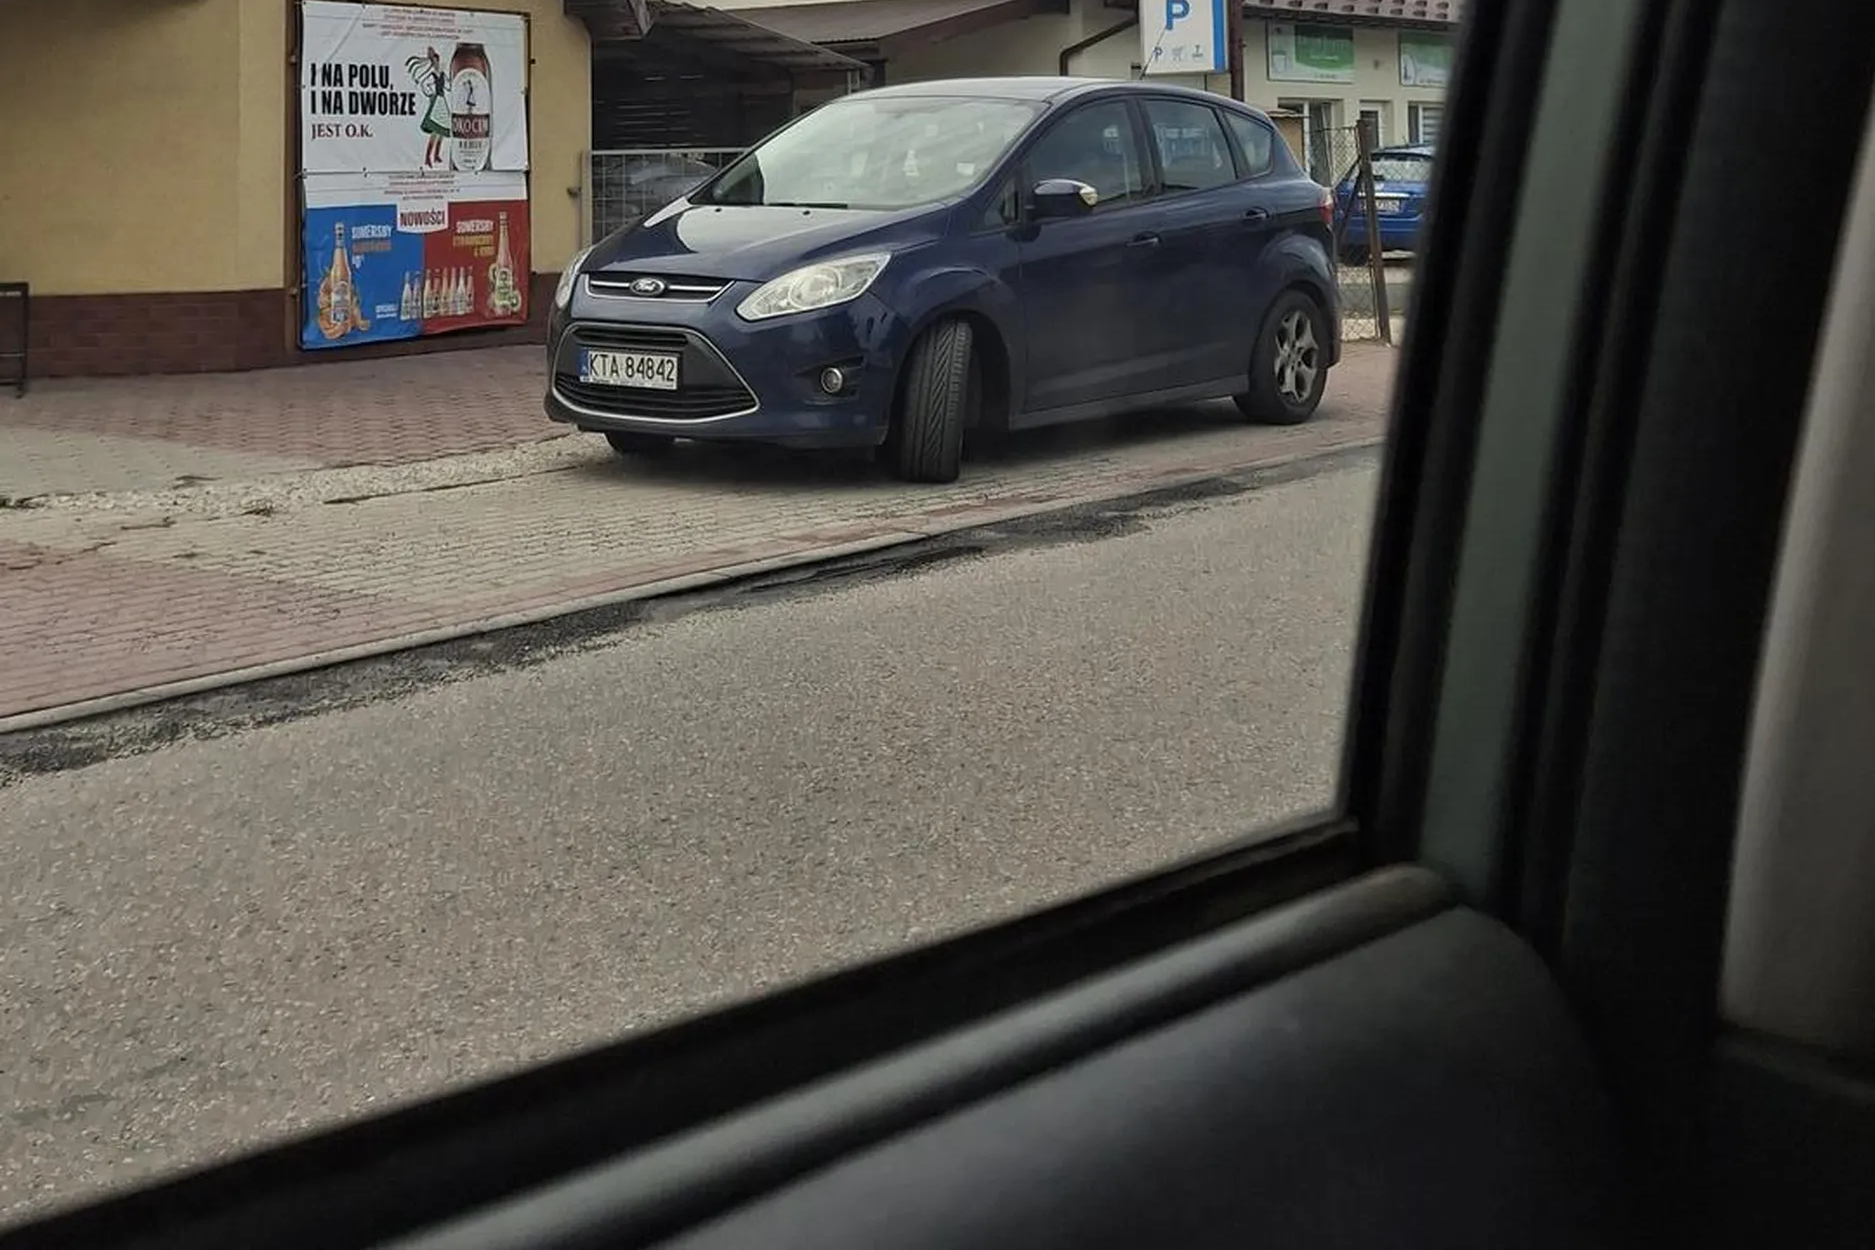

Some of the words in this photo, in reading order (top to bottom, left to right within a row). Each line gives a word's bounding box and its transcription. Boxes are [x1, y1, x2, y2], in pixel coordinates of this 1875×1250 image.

[310, 63, 317, 87] I
[321, 63, 343, 87] NA
[348, 64, 394, 90] POLU,
[310, 90, 317, 115] I
[321, 90, 343, 115] NA
[348, 91, 416, 116] DWORZE
[311, 123, 342, 139] JEST
[345, 123, 374, 139] O.K.
[400, 207, 446, 227] NOWOŚCI
[590, 354, 620, 378] KTA
[625, 356, 675, 382] 84842
